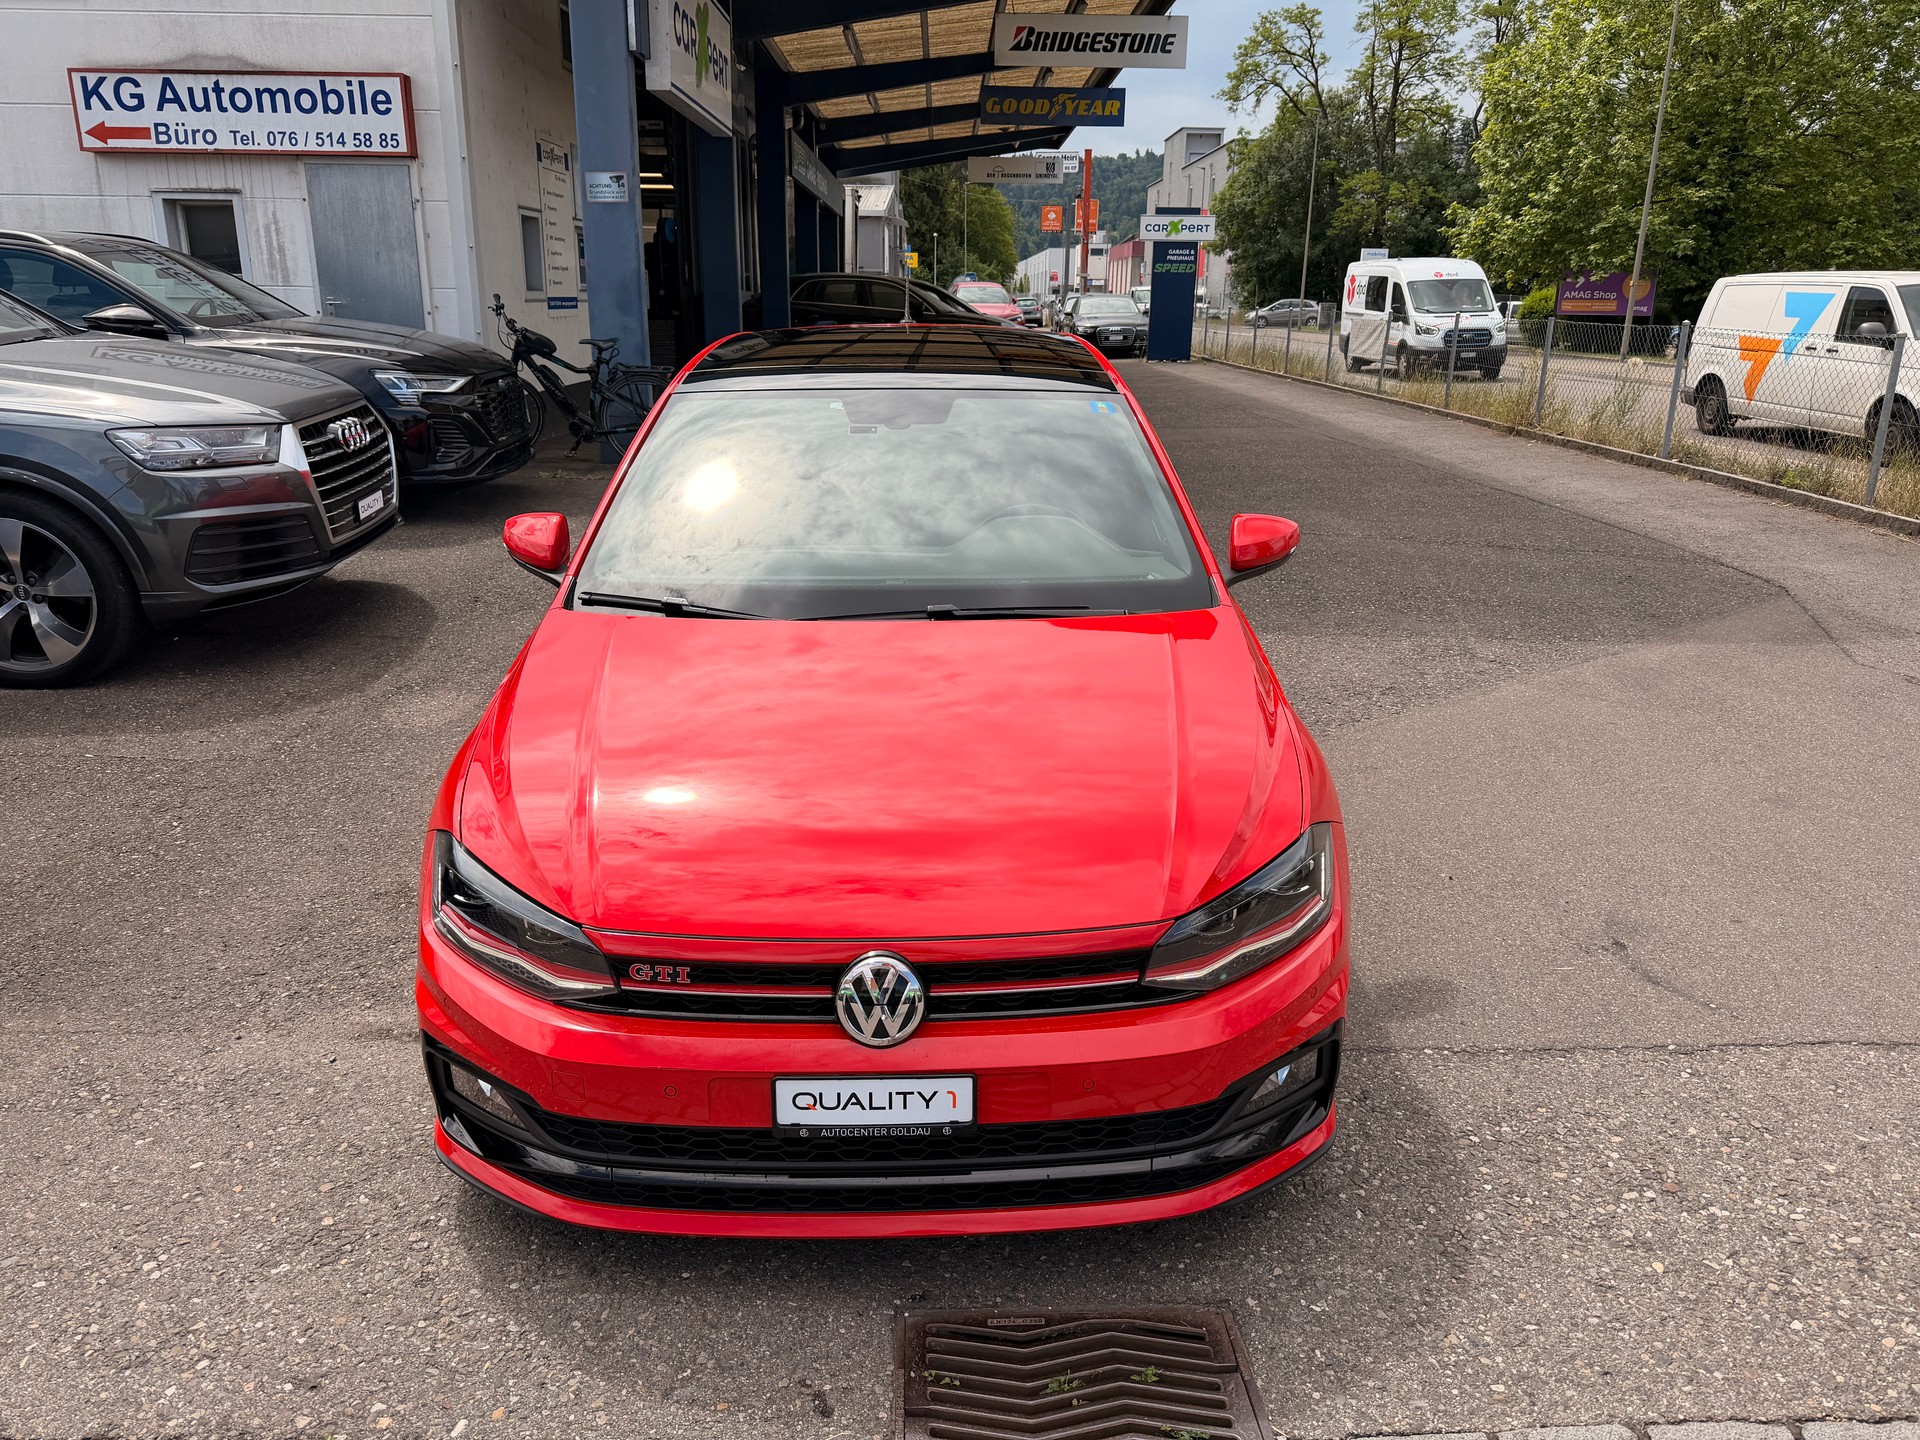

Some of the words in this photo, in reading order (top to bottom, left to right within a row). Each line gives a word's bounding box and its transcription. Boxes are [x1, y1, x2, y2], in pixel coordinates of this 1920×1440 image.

[1008, 25, 1177, 54] BRIDGESTONE
[79, 75, 146, 112] KG
[156, 76, 393, 116] Automobile
[985, 95, 1121, 118] GOODYEAR
[153, 122, 218, 145] Büro
[229, 130, 261, 146] Tel.
[266, 131, 299, 147] 076
[315, 132, 347, 148] 514
[353, 132, 373, 148] 58
[379, 133, 400, 149] 85
[1153, 263, 1196, 272] SPEED
[1356, 280, 1368, 298] dpd
[1593, 291, 1617, 300] Shop
[361, 498, 379, 513] QUALITY
[629, 963, 691, 983] GTI
[791, 1090, 939, 1111] QUALITY
[947, 1090, 957, 1109] 1
[820, 1128, 888, 1137] AUTOCENTER
[890, 1127, 931, 1136] GOLDAU
